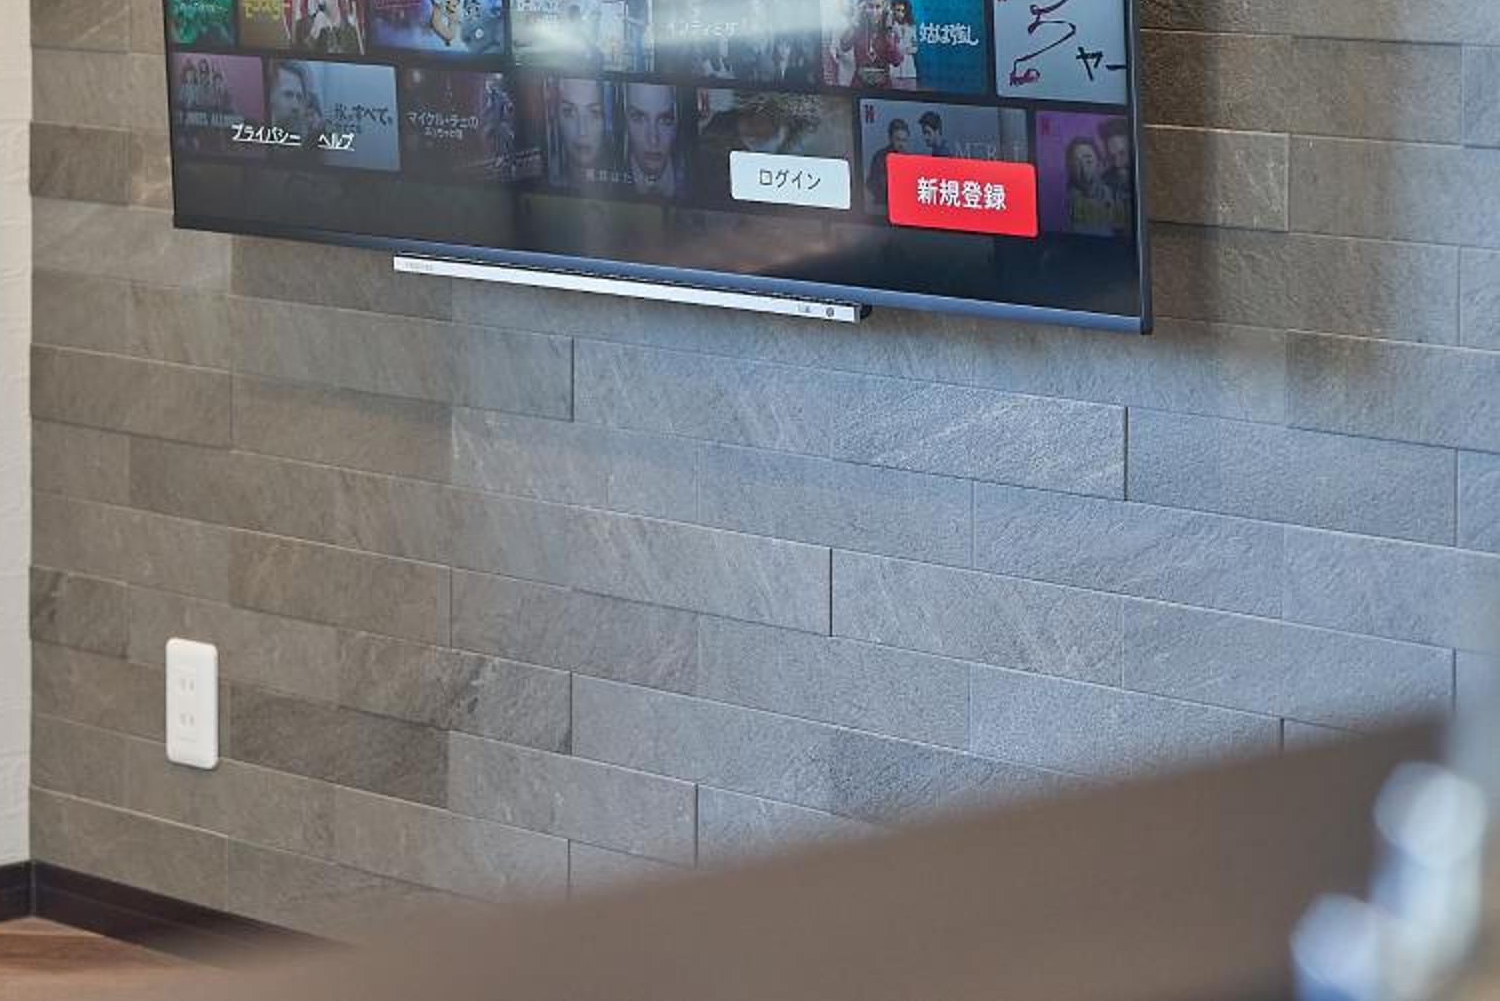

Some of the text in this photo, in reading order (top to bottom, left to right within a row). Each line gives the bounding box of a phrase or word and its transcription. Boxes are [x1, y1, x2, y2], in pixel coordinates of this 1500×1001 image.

[232, 123, 301, 146] プライバシー
[318, 133, 355, 151] ヘルプ
[759, 168, 822, 191] ログイン
[916, 176, 1008, 212] 新規登録
